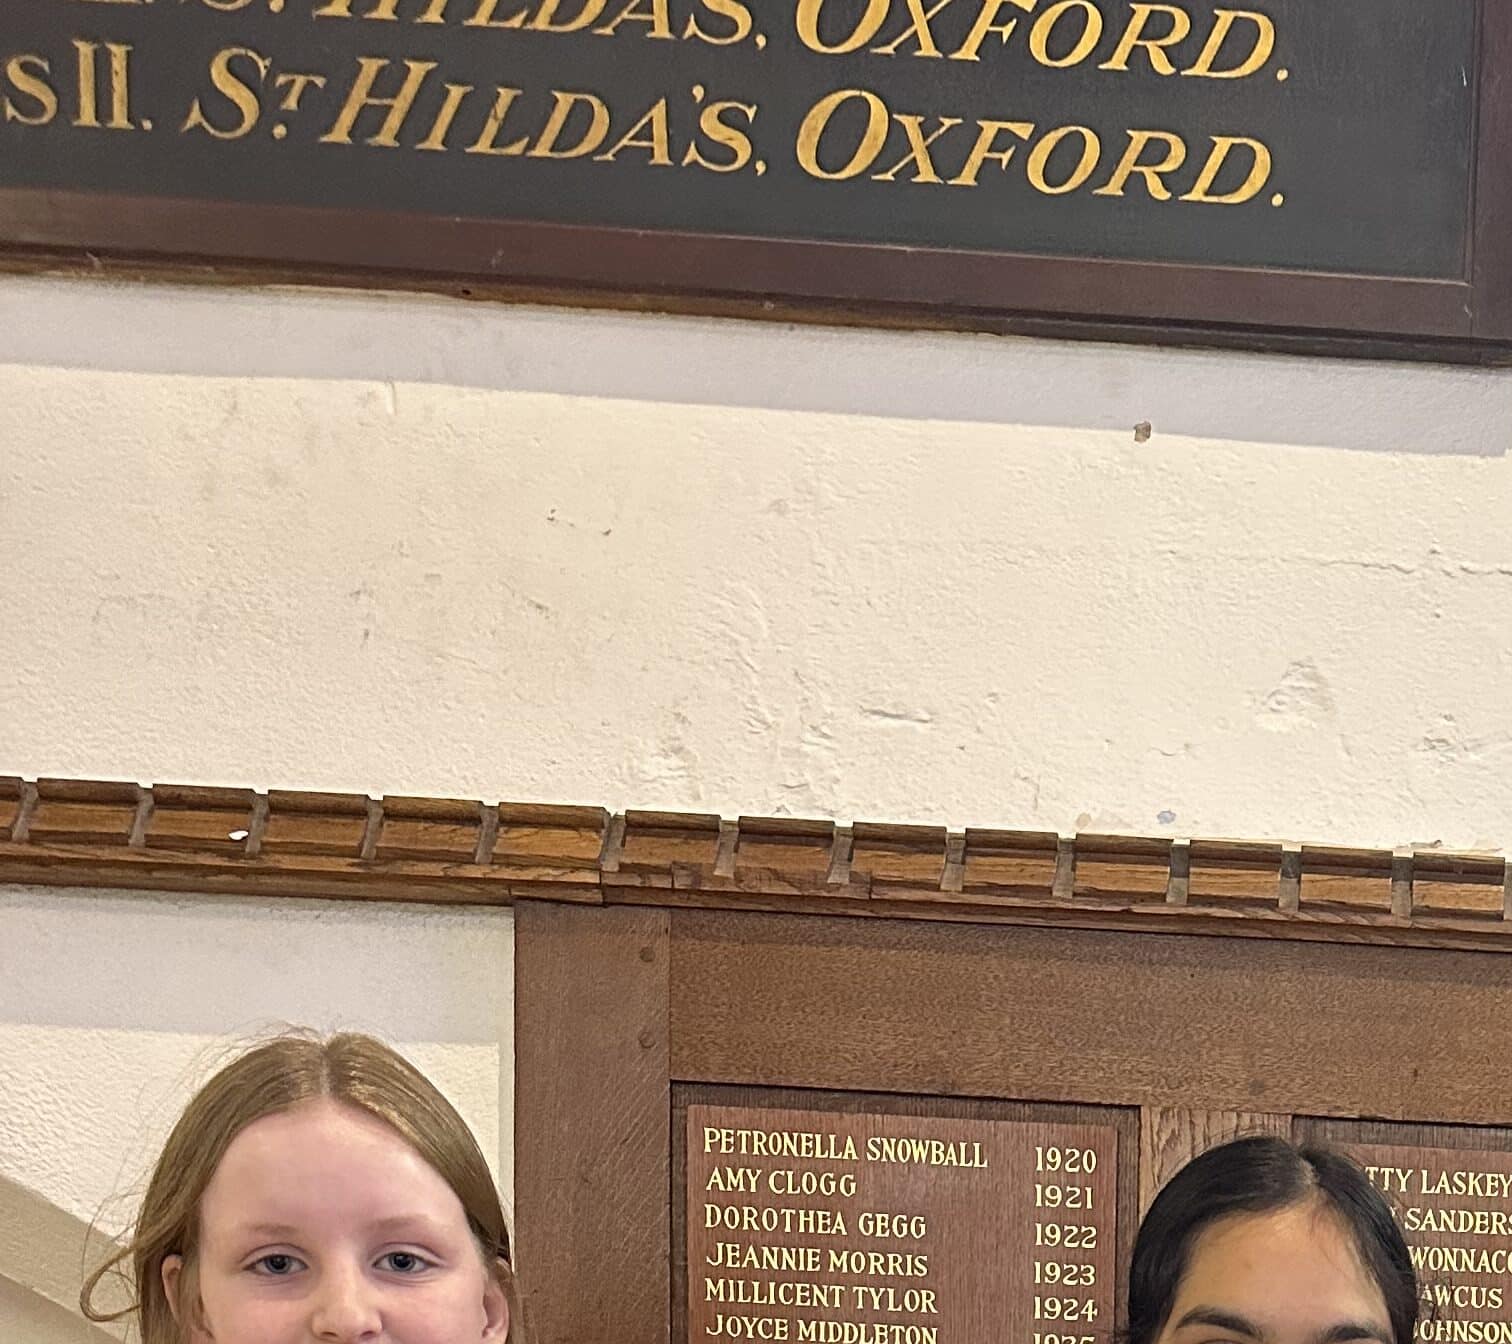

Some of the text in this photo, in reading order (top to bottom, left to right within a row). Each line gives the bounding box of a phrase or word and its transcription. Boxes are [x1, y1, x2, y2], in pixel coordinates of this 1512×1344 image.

[797, 90, 1283, 206] OXFORD.
[704, 1128, 1096, 1173] PETRONELLA SNOWBALL 1920
[706, 1167, 1092, 1209] AMY CLOGG 1921
[705, 1204, 1096, 1248] DOROTHEA GEGG 1922
[705, 1278, 1097, 1321] MILLICENT TYLOR 1924
